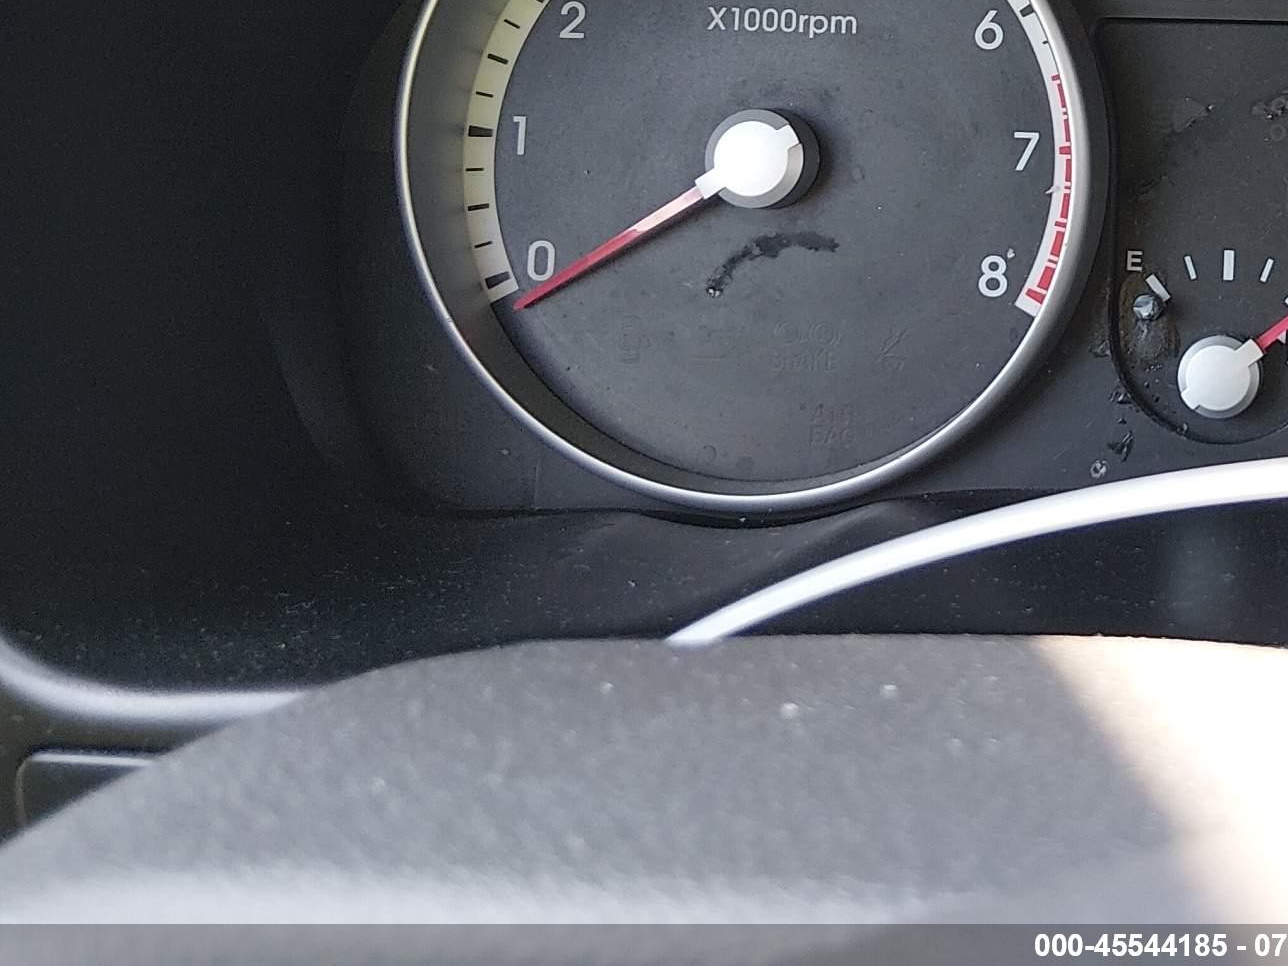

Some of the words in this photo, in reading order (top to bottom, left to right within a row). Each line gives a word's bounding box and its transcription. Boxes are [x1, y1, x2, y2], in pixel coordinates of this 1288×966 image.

[559, 1, 586, 39] 2
[707, 6, 858, 38] X1000rpm
[974, 10, 1004, 50] 6
[513, 115, 528, 155] 1
[1013, 131, 1040, 172] 7
[528, 240, 556, 282] 0
[978, 255, 1008, 297] 8
[1126, 250, 1144, 272] E
